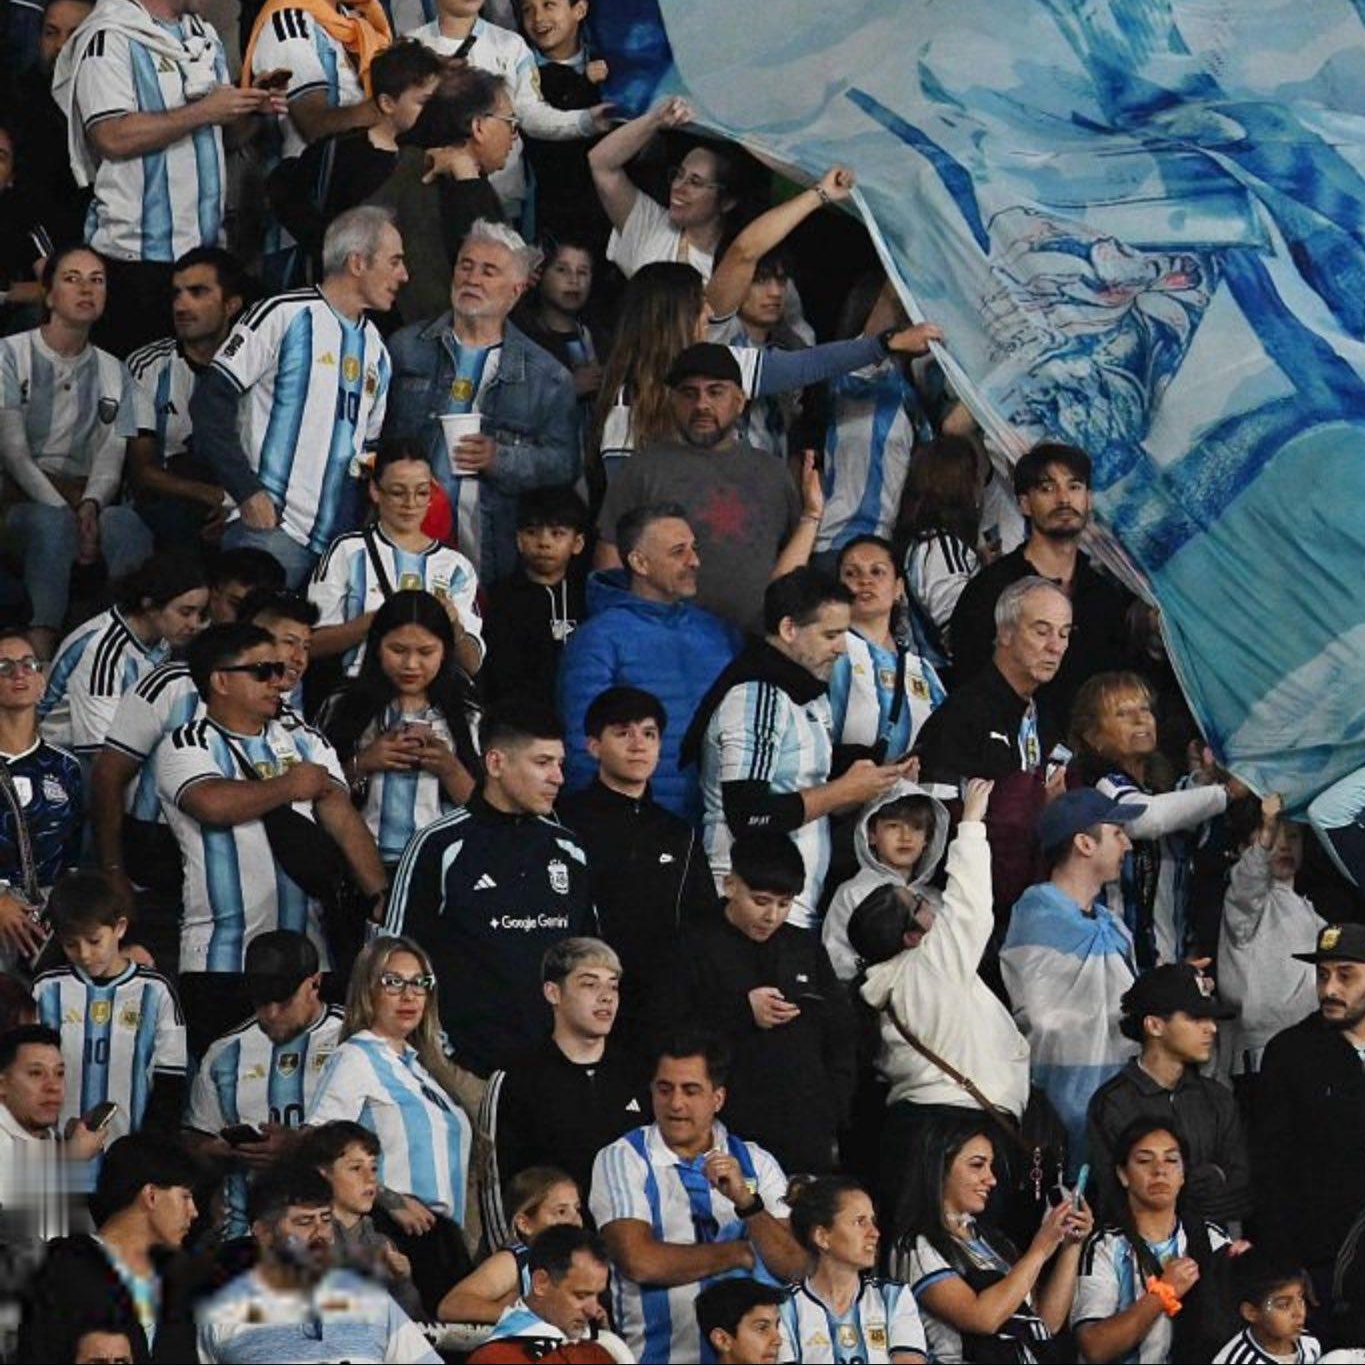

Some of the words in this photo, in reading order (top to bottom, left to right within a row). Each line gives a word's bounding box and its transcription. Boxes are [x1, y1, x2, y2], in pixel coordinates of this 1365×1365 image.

[503, 914, 538, 932] Google
[538, 912, 569, 929] Gemini
[85, 1036, 109, 1066] 10
